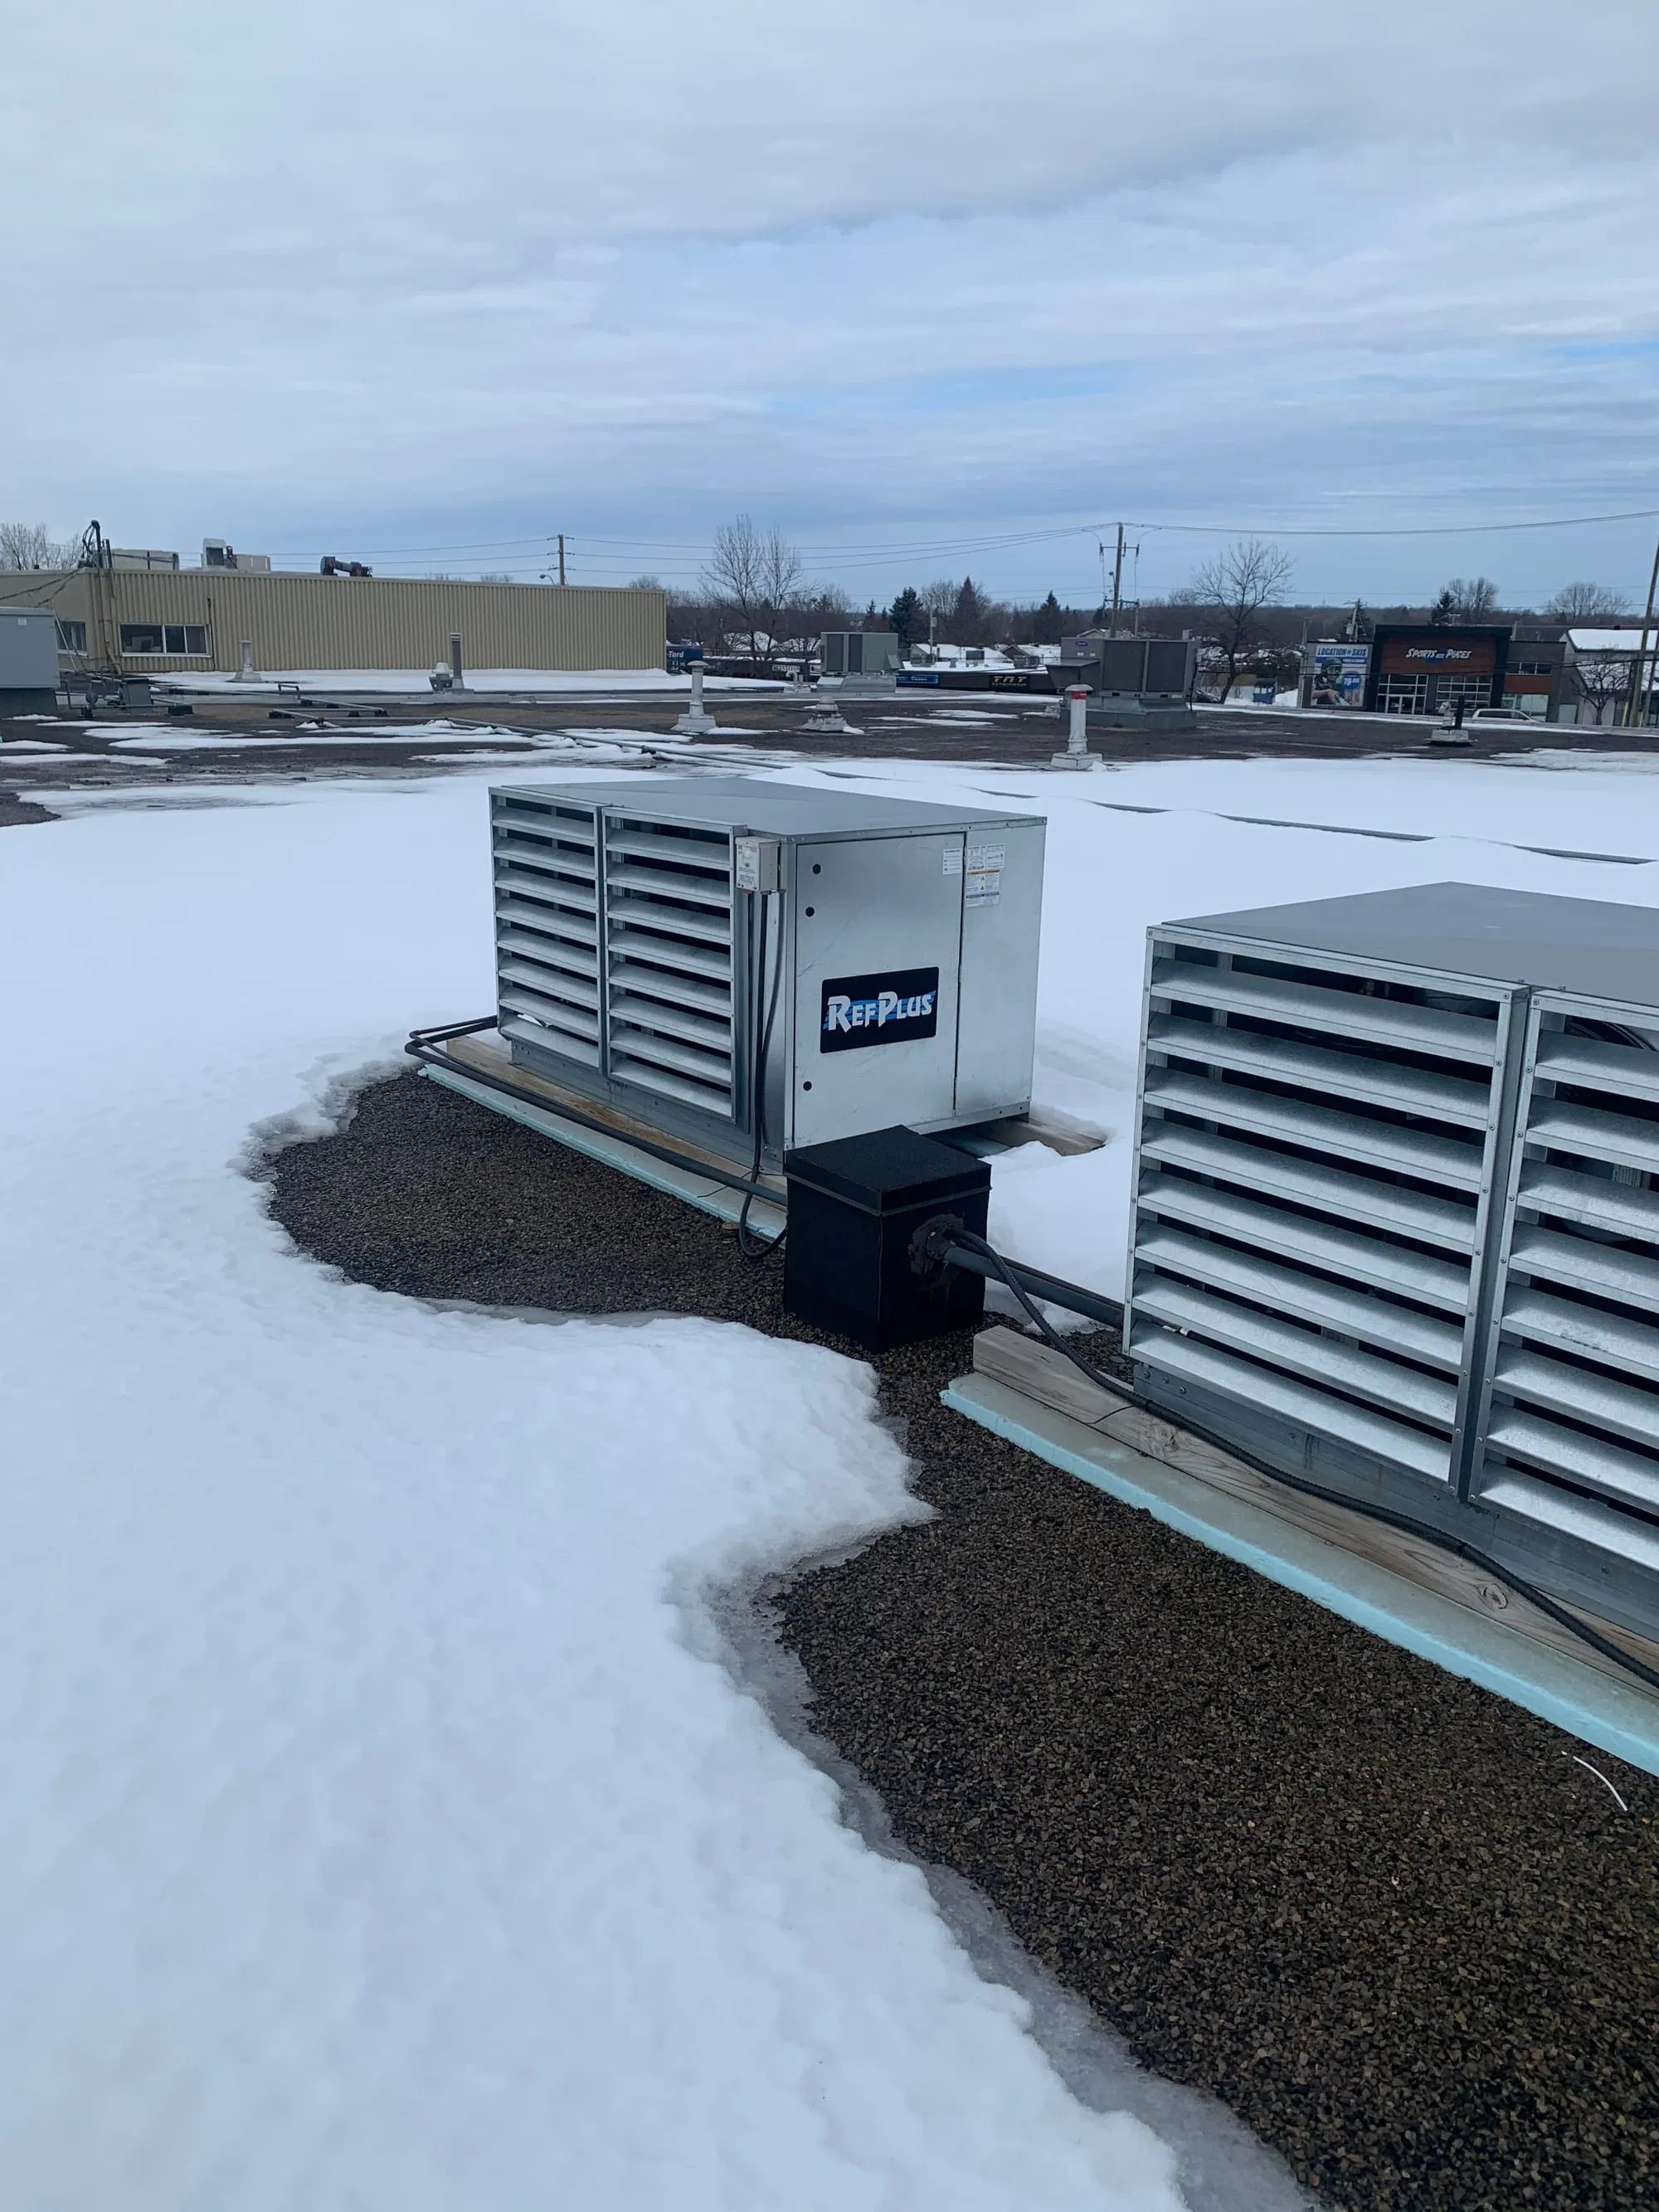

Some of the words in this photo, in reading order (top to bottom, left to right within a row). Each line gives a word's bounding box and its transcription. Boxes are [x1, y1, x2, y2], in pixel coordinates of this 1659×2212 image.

[1317, 647, 1347, 656] LOCATION
[1351, 648, 1368, 657] SKIS
[1405, 647, 1438, 659] SPORTS
[1445, 648, 1472, 659] PUCES
